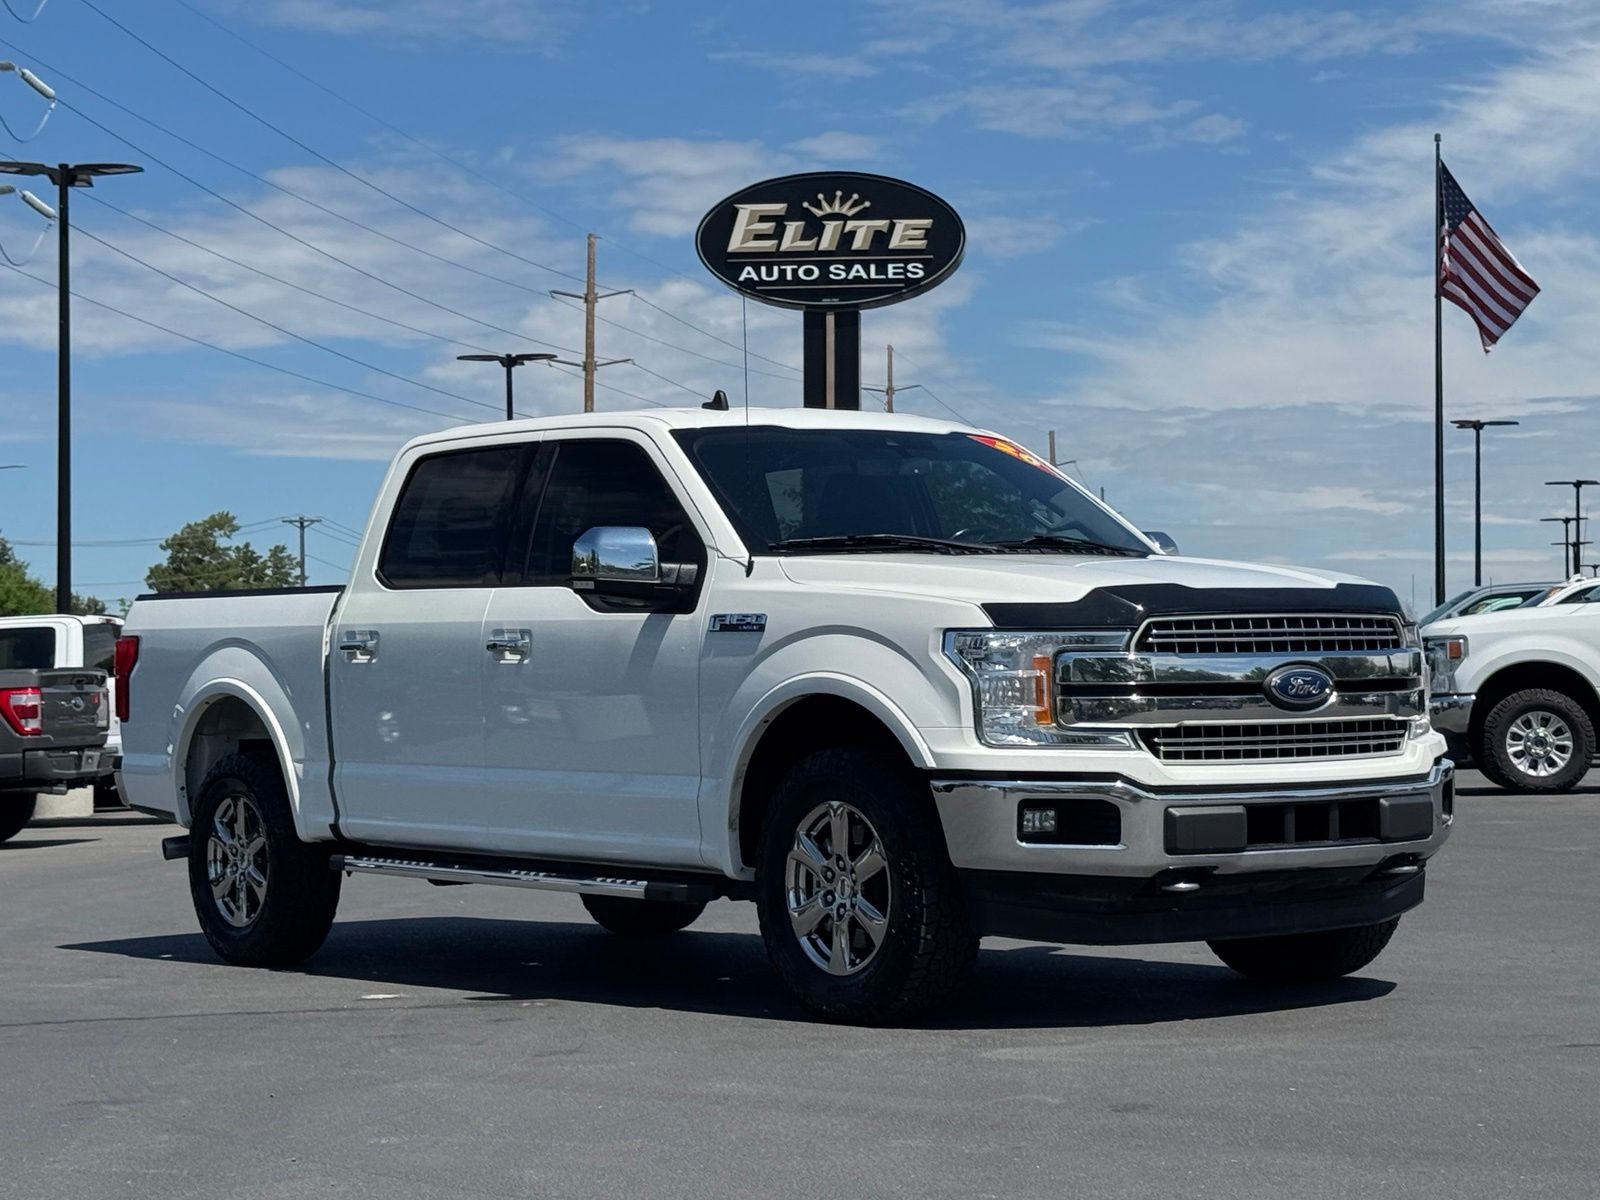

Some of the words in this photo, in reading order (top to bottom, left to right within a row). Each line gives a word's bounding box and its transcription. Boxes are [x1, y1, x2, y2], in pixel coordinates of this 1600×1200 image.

[727, 203, 933, 252] ELITE
[738, 265, 819, 281] AUTO
[828, 262, 925, 280] SALES
[1288, 676, 1320, 695] Ford
